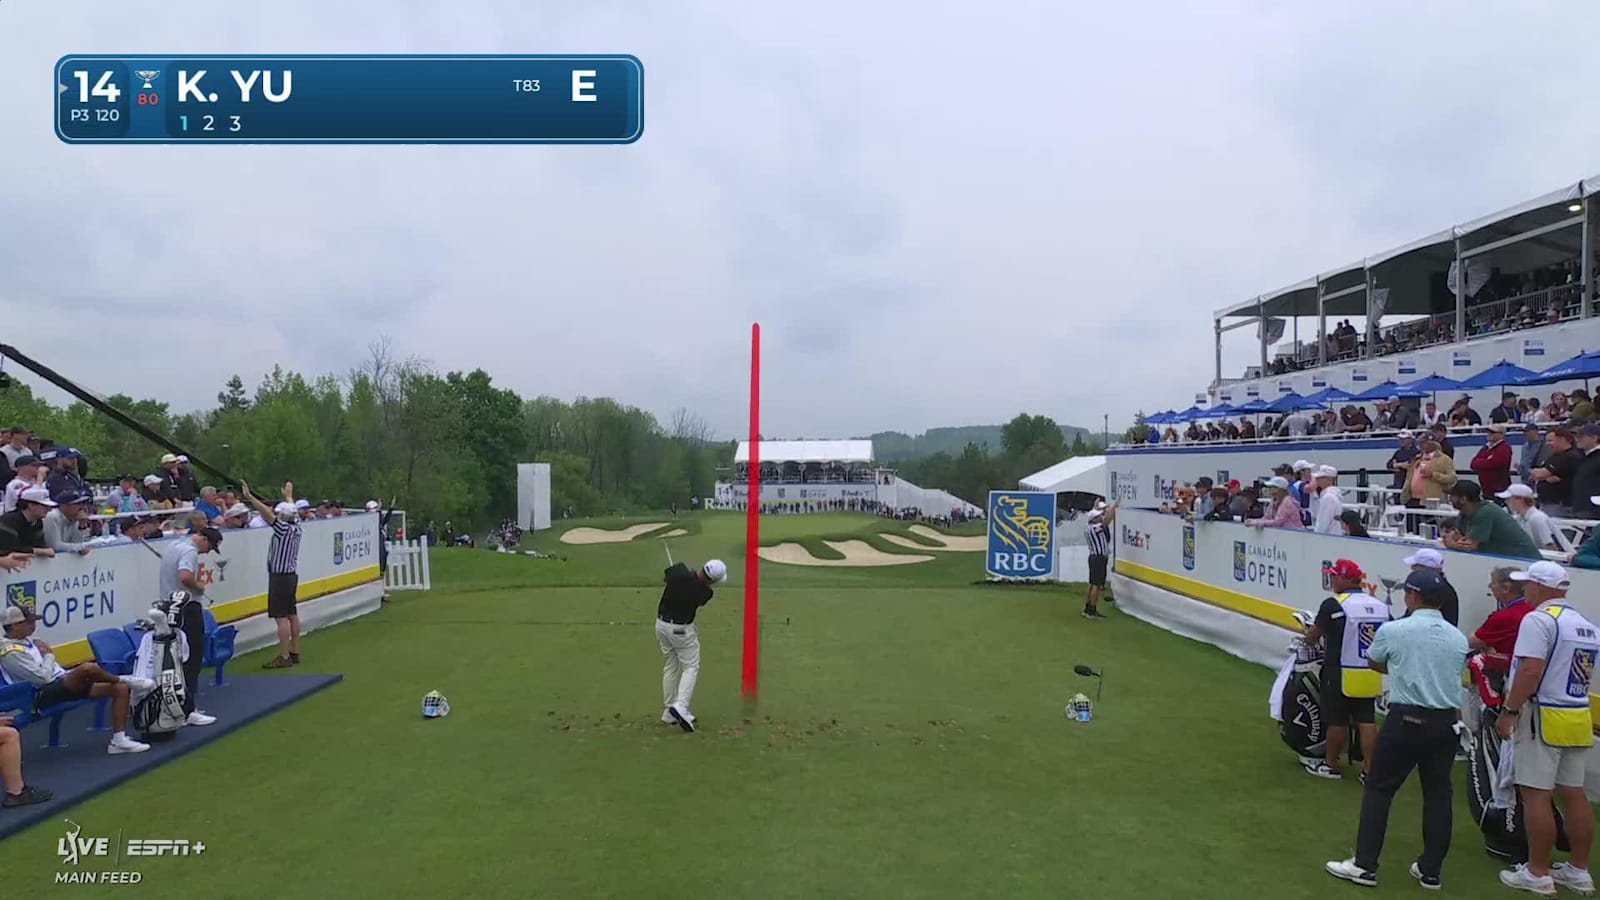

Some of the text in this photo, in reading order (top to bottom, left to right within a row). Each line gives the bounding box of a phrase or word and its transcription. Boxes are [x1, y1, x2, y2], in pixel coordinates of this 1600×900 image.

[344, 540, 371, 560] OPEN
[994, 551, 1047, 572] RBC
[1247, 543, 1288, 562] CANADIAN
[43, 566, 115, 594] CANADIAN
[1247, 560, 1288, 590] OPEN
[42, 589, 115, 628] OPEN
[167, 590, 186, 625] PING
[162, 671, 176, 706] PING
[1296, 693, 1321, 743] Callaway
